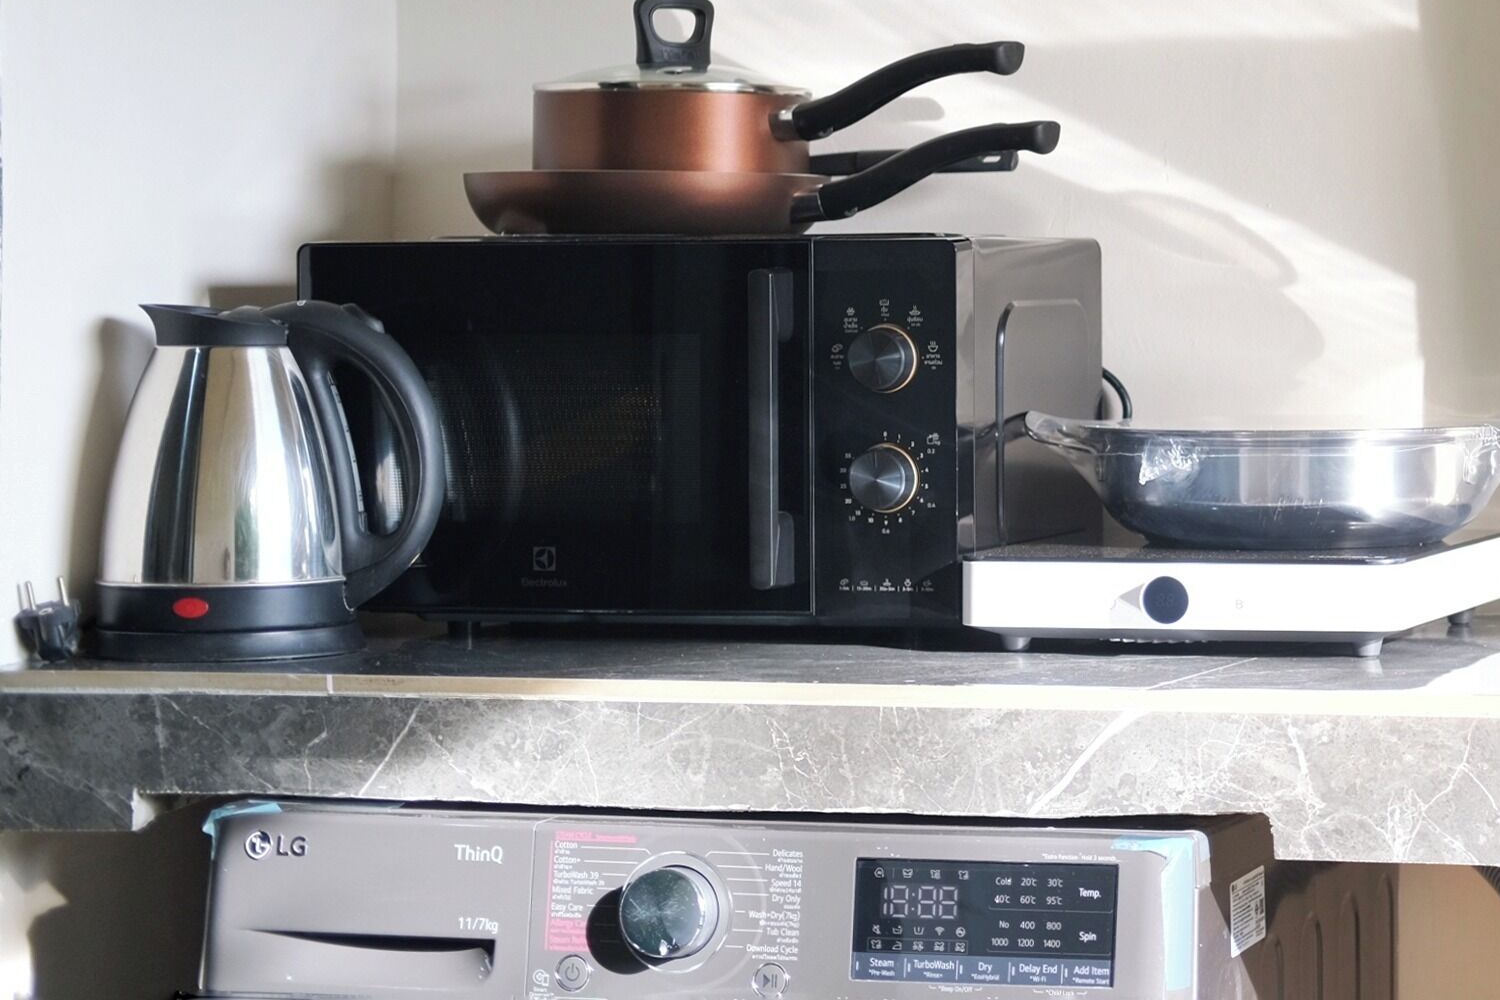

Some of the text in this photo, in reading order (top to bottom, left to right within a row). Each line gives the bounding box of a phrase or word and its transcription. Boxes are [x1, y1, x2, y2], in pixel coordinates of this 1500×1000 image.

[276, 833, 308, 857] LG
[554, 840, 578, 848] Cotton
[453, 843, 504, 865] ThinQ
[772, 849, 803, 858] Delicates
[764, 864, 803, 873] Hand/Wool
[771, 878, 792, 888] Speed
[995, 877, 1012, 886] Cold
[552, 886, 594, 895] Mixed Fabric
[1078, 887, 1102, 900] Temp.
[772, 894, 800, 905] Dry Only
[551, 902, 583, 912] Easy Care
[458, 916, 499, 935] 11/7kg
[998, 920, 1062, 931] No 400 800
[766, 927, 800, 937] Tub Clean
[1078, 931, 1097, 943] Spin
[991, 938, 1061, 948] 1000 1200 1400
[746, 944, 799, 955] Download Cycle
[870, 957, 895, 968] Steam
[913, 960, 955, 970] TurboWash
[978, 962, 992, 974] Dry
[1018, 963, 1058, 975] Delay End
[1073, 966, 1110, 976] Add Item
